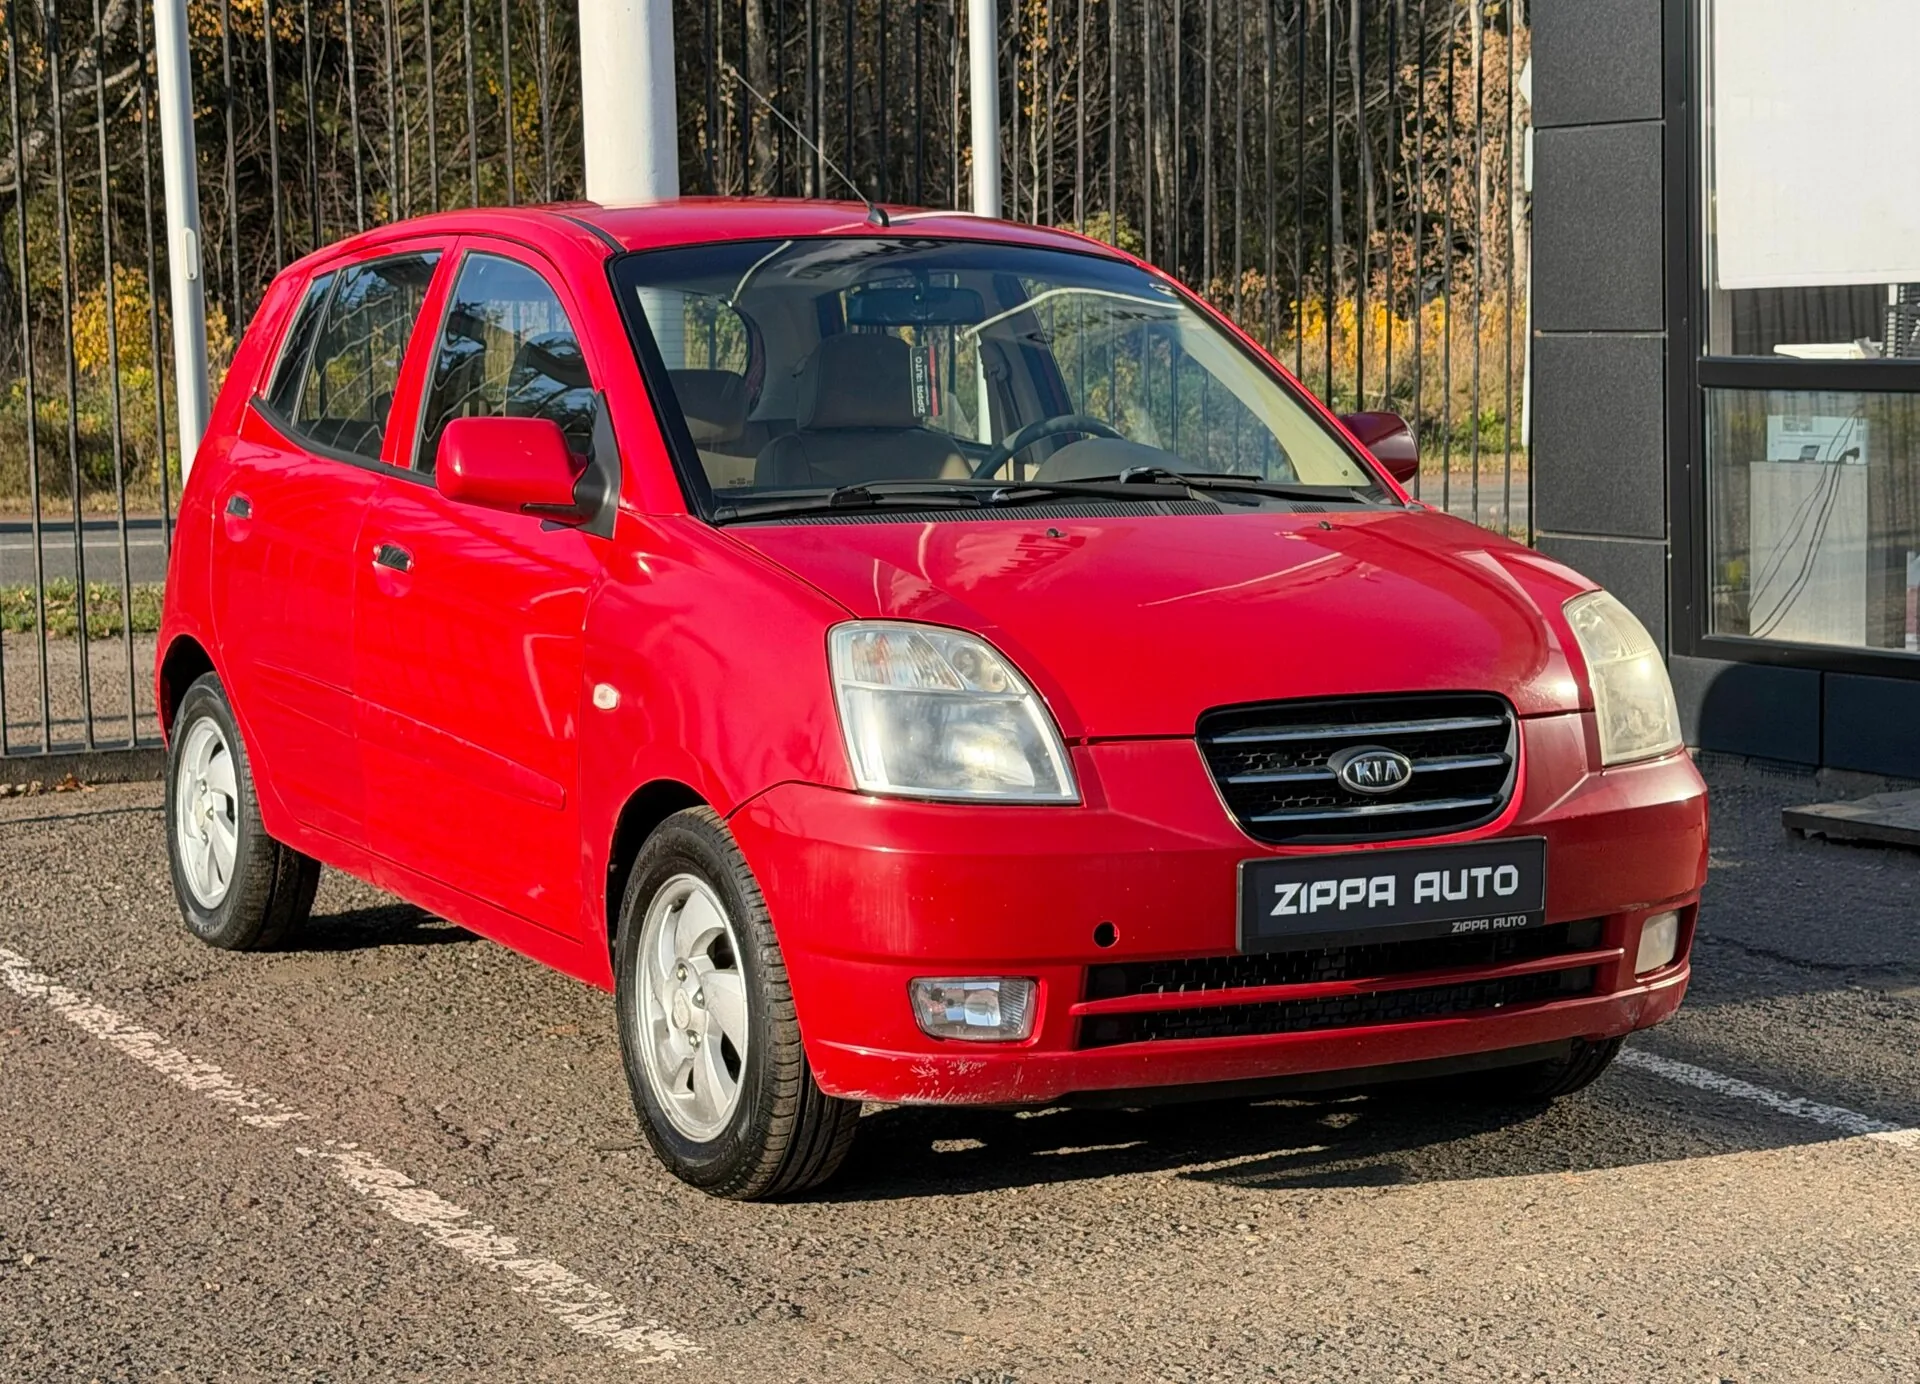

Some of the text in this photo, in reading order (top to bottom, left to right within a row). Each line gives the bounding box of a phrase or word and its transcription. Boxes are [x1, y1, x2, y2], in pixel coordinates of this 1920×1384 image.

[915, 356, 926, 414] ZIPPA AUTO
[1354, 759, 1402, 783] KIA
[1270, 864, 1519, 916] ZIPPA AUTO
[1451, 915, 1527, 933] ZIPPA AUTO
